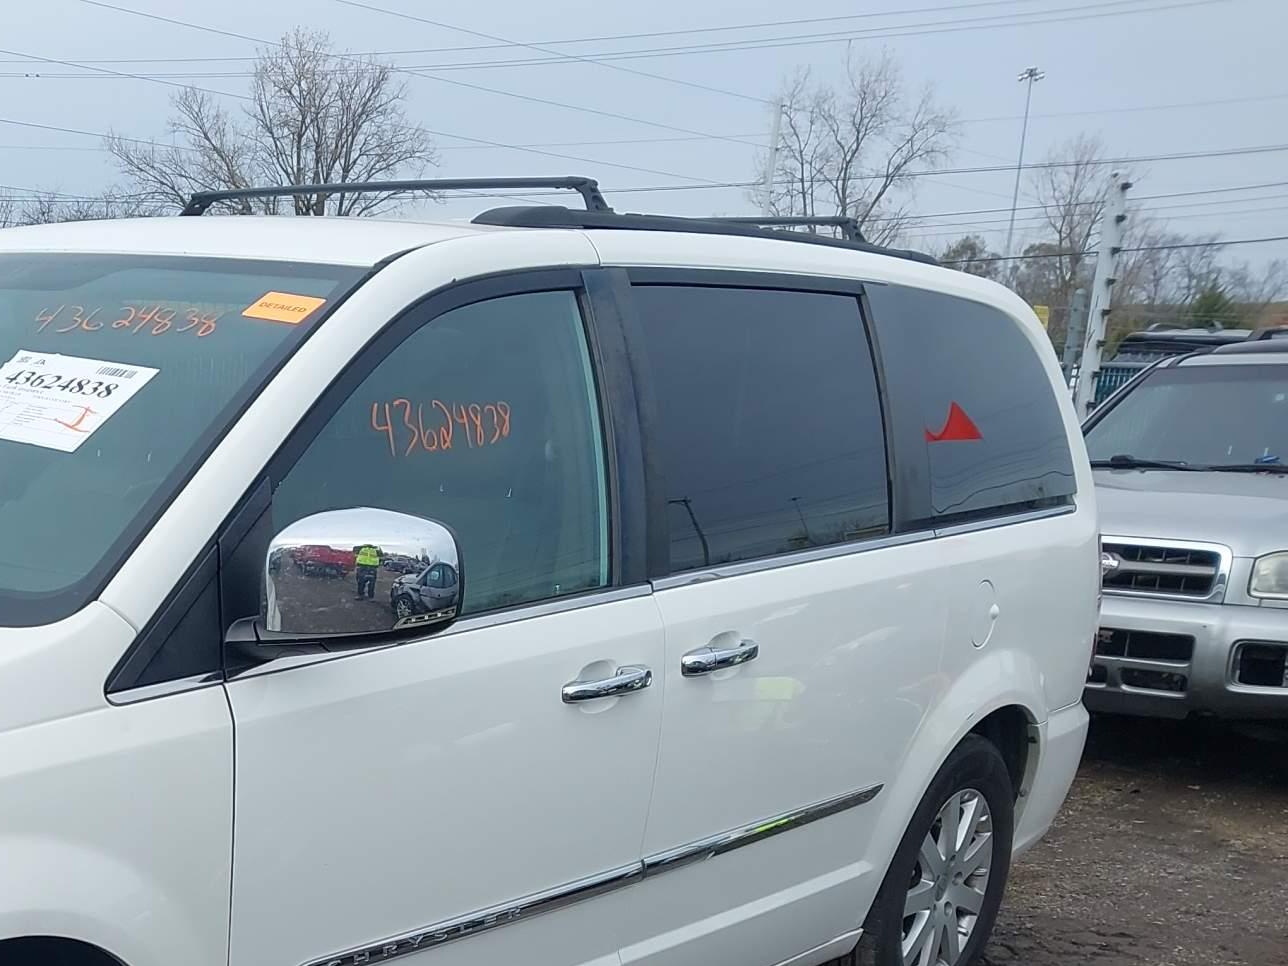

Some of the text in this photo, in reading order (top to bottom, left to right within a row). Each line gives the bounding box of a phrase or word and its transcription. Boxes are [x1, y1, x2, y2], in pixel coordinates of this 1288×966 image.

[34, 303, 222, 337] 43624838
[258, 300, 308, 315] DETAILED
[5, 370, 120, 400] 43624838
[372, 398, 512, 457] 43624838
